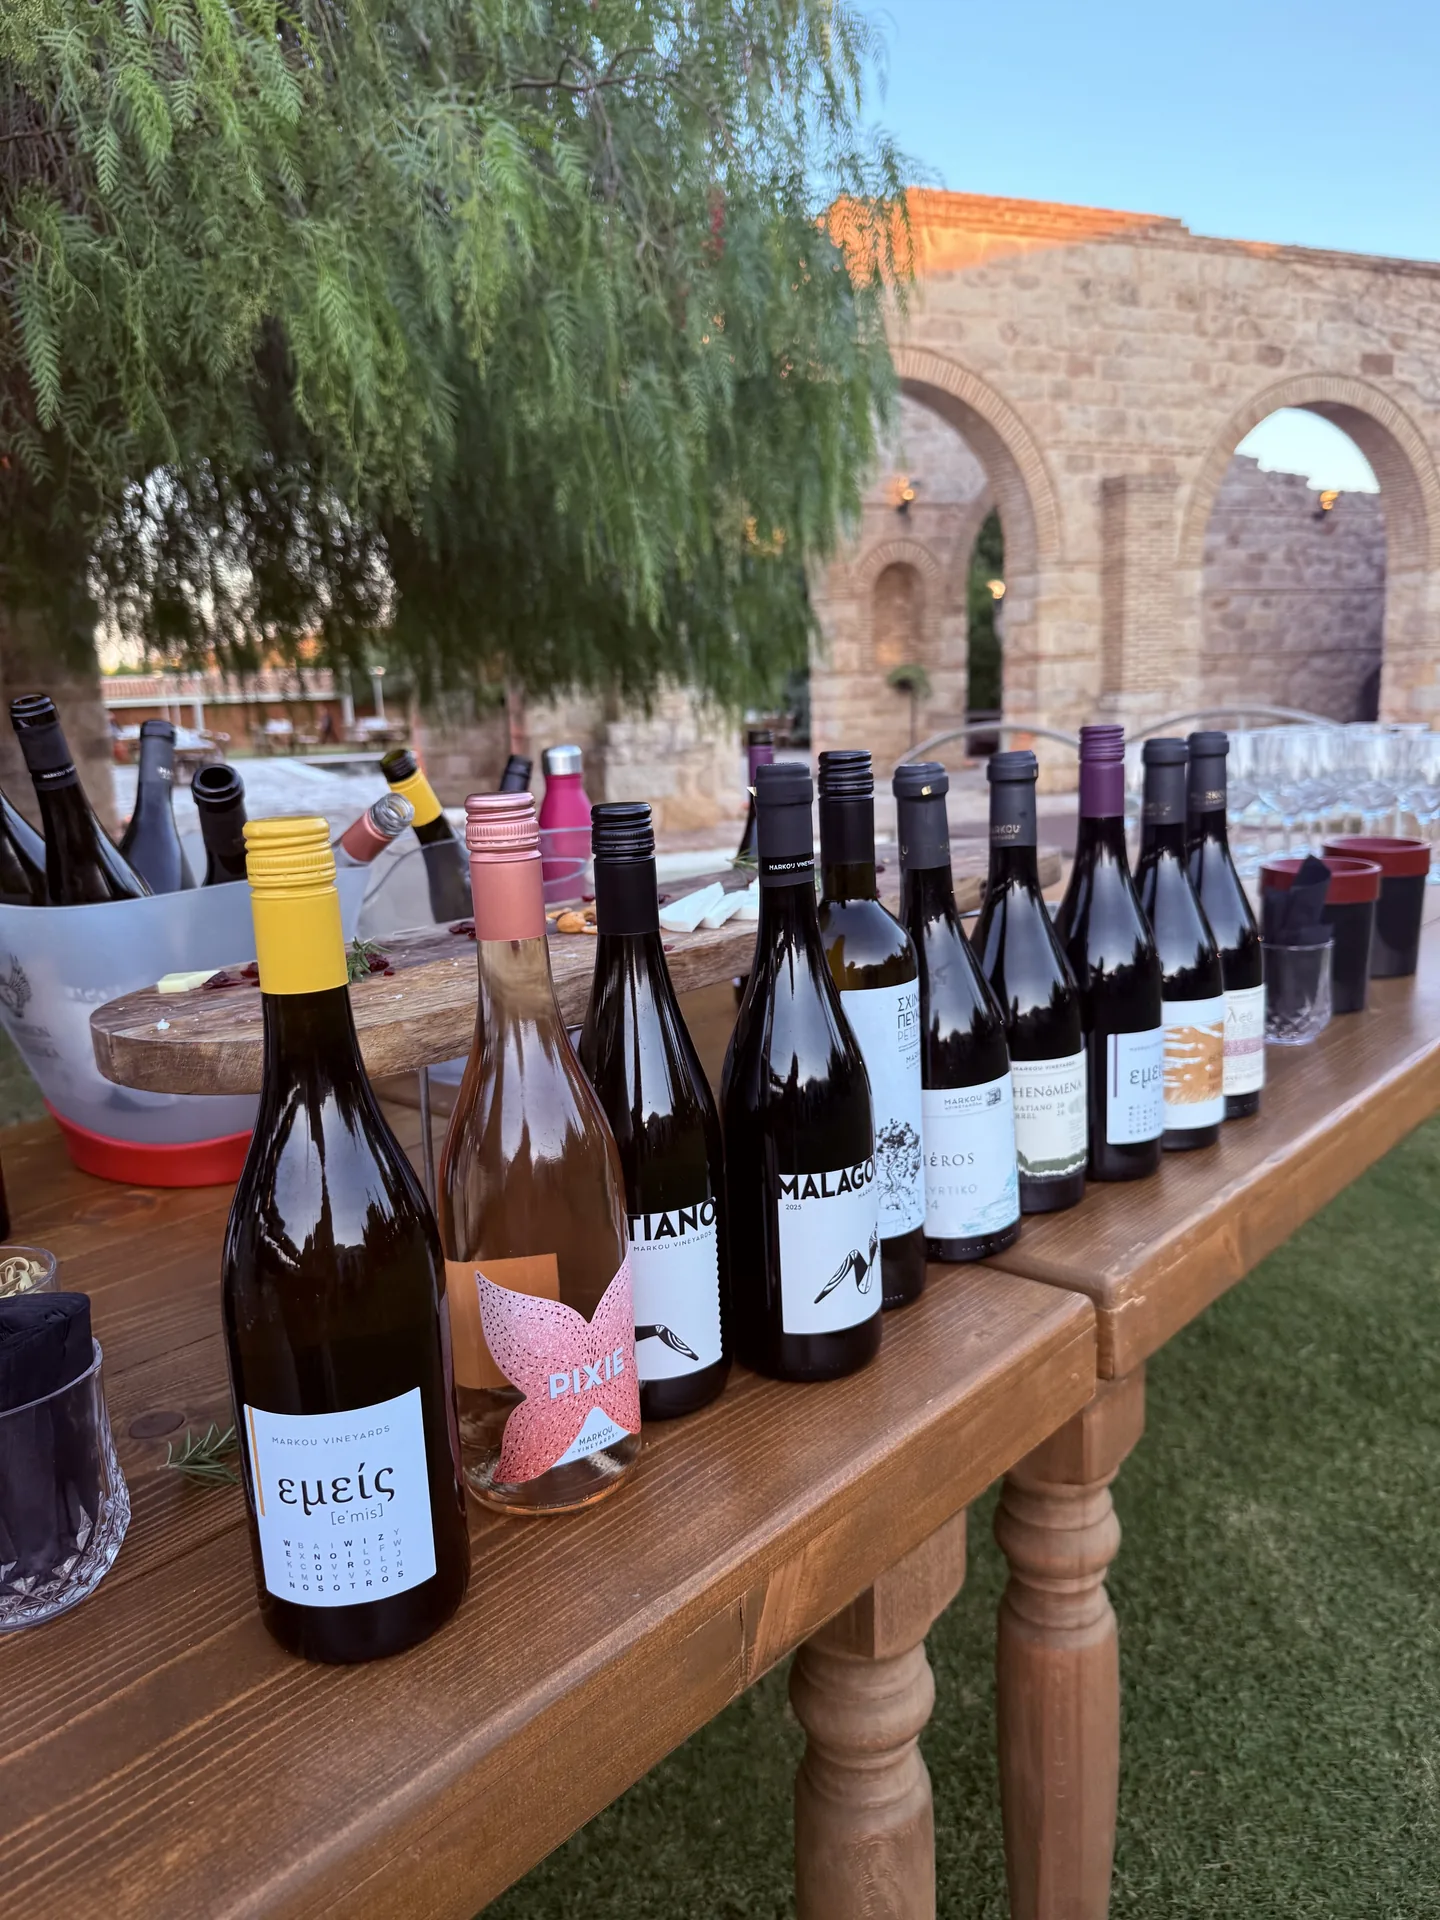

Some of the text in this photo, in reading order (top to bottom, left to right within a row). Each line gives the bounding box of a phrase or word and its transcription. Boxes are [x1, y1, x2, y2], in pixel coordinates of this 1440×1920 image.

[944, 1094, 983, 1106] MARKOU
[777, 1156, 877, 1201] MALAGO
[925, 1183, 978, 1197] YRTIKO
[785, 1203, 802, 1211] 2025
[627, 1197, 716, 1242] TIANO
[633, 1230, 712, 1252] MARKOU VINEYARDS
[549, 1346, 624, 1400] PIXIE
[271, 1424, 391, 1447] MARKOU VINEYARDS
[579, 1424, 614, 1446] MARKOU
[277, 1461, 396, 1517] εμείς
